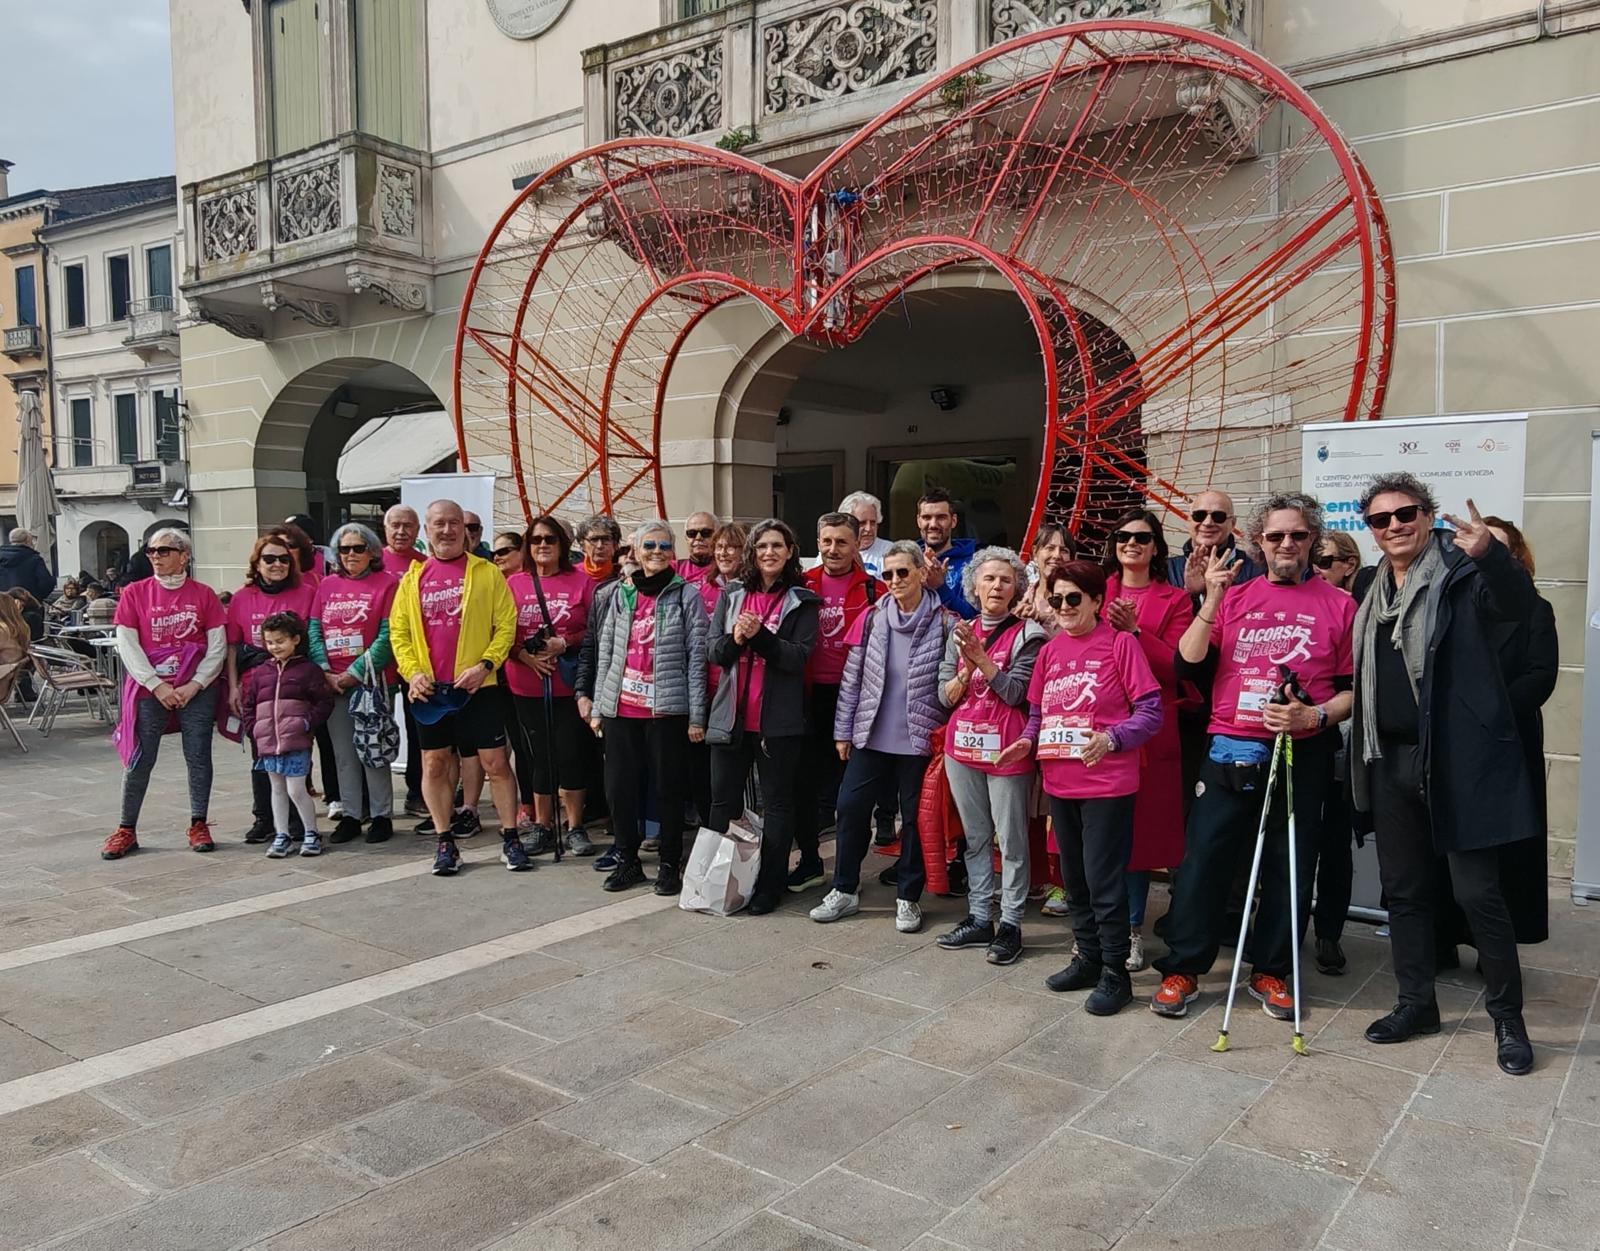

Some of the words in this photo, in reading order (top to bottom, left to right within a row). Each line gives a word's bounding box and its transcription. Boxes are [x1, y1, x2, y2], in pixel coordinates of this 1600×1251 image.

[1464, 469, 1495, 477] VENEZIA
[151, 611, 194, 627] LACORSA
[1238, 625, 1304, 642] LACORSA
[630, 682, 649, 695] 351
[1044, 671, 1091, 694] LACORSA
[963, 736, 984, 748] 324
[1049, 731, 1074, 743] 315
